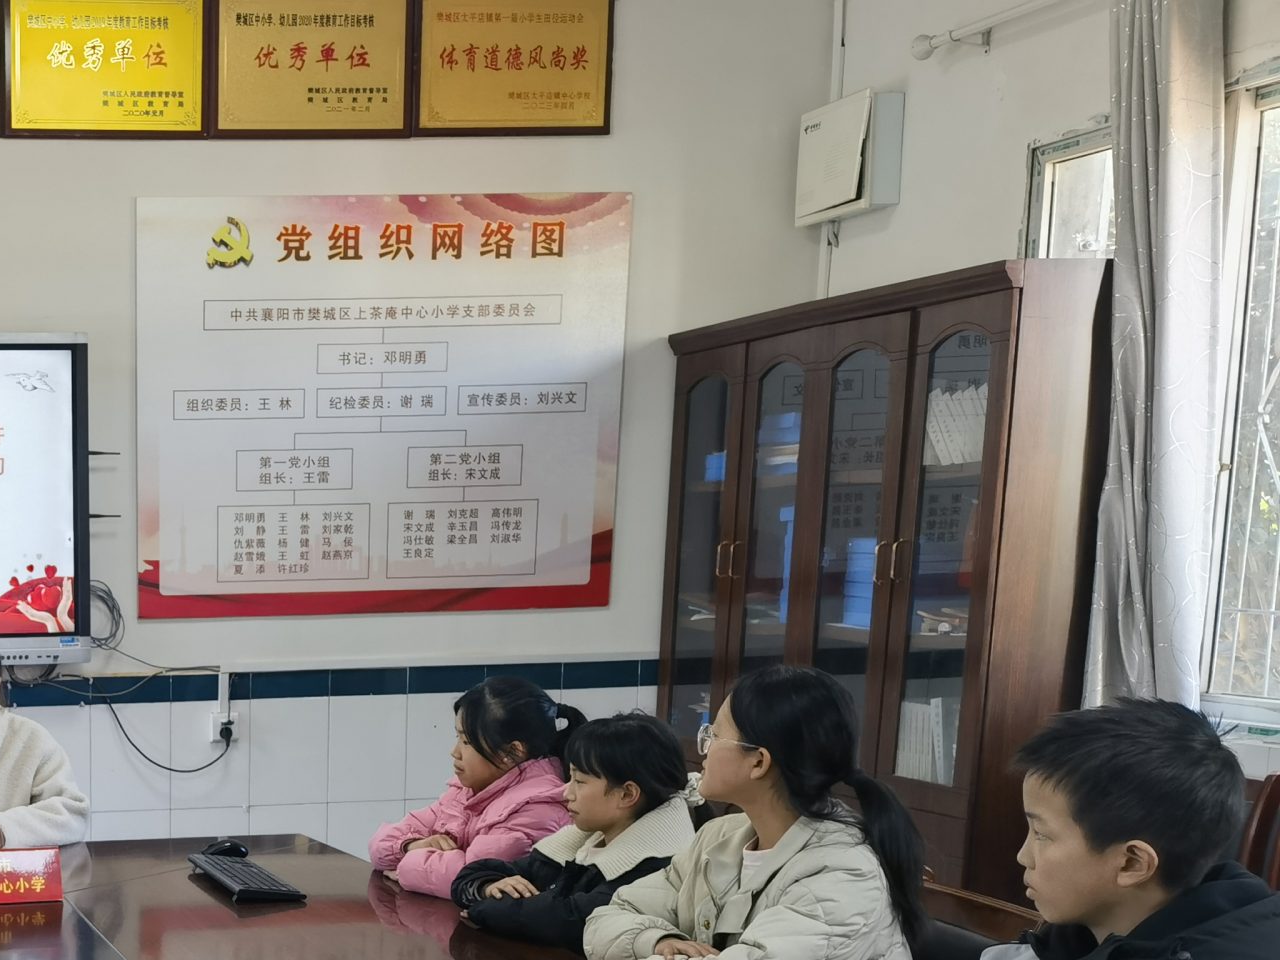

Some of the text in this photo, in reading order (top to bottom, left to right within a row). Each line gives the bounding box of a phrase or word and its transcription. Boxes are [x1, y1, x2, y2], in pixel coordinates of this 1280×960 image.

[47, 38, 168, 72] 优秀单位
[254, 41, 371, 73] 优秀单位
[439, 43, 590, 73] 体育道德风尚奖
[276, 220, 567, 263] 党组织网络图
[230, 302, 537, 323] 中共襄阳市樊城区上茶庵中心小学支部委员会
[259, 455, 331, 470] 第一党小组
[430, 452, 501, 466] 第二党小组
[234, 512, 266, 524] 邓明勇
[322, 511, 354, 522] 刘兴文
[491, 507, 523, 518] 高伟明
[403, 522, 435, 533] 宋文成
